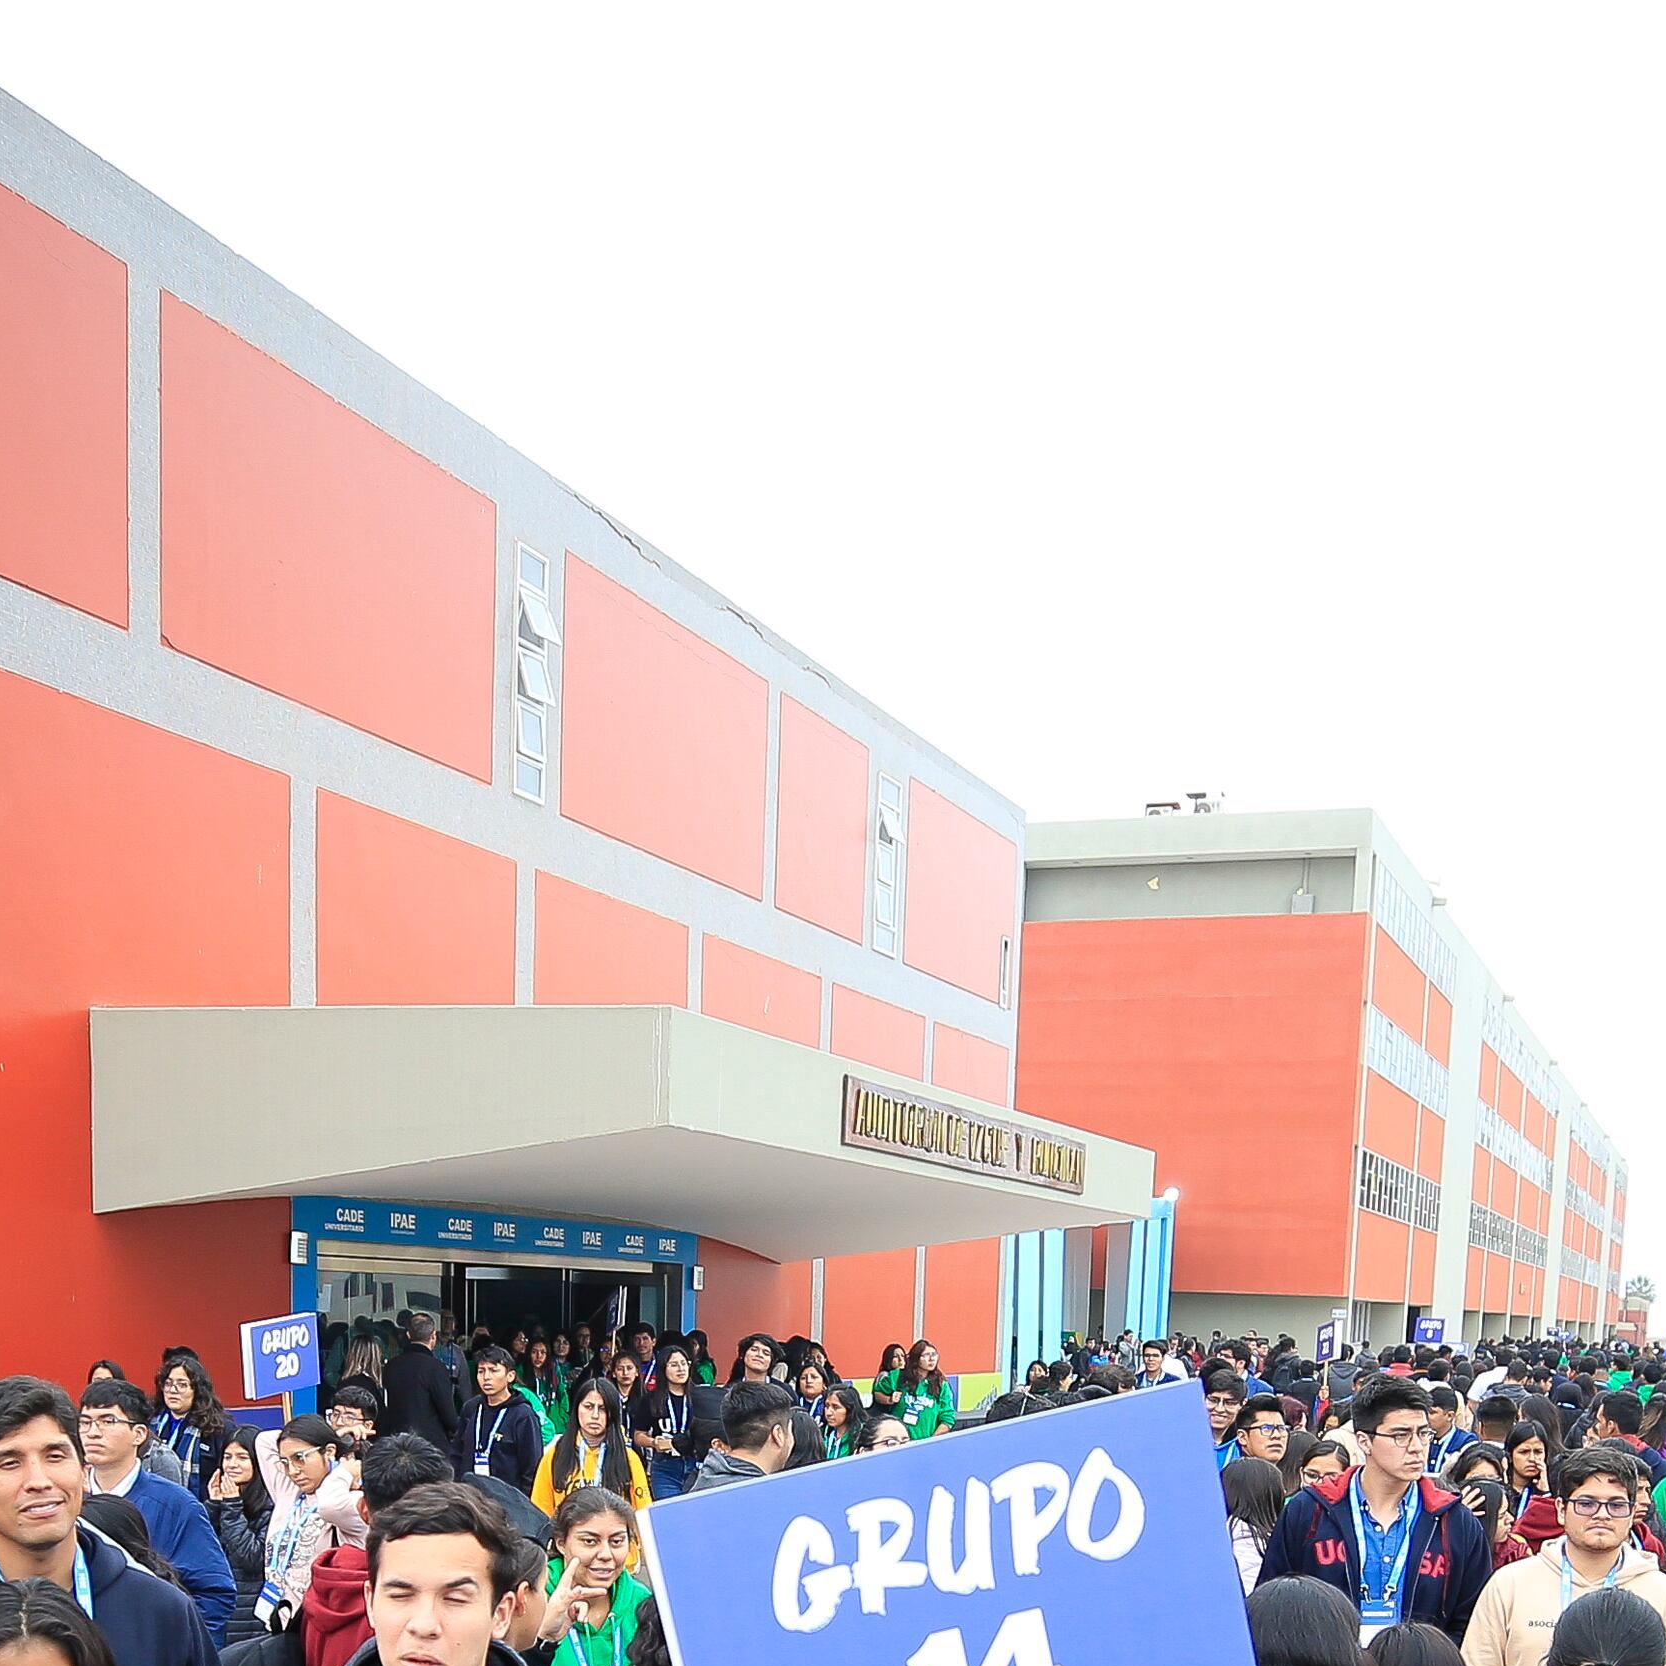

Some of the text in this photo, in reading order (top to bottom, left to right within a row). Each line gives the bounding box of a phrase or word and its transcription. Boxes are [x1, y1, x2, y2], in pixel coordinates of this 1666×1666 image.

[336, 1208, 364, 1223] CADE
[390, 1213, 416, 1229] IPAE
[448, 1218, 472, 1232] CADE
[493, 1222, 515, 1237] IPAE
[543, 1227, 565, 1240] CADE
[582, 1231, 602, 1246] IPAE
[625, 1235, 644, 1247] CADE
[659, 1239, 676, 1252] IPAE
[262, 1324, 309, 1352] GRUPO
[276, 1353, 300, 1378] 20
[772, 1447, 1146, 1633] GRUPO
[1528, 1619, 1556, 1628] asoci
